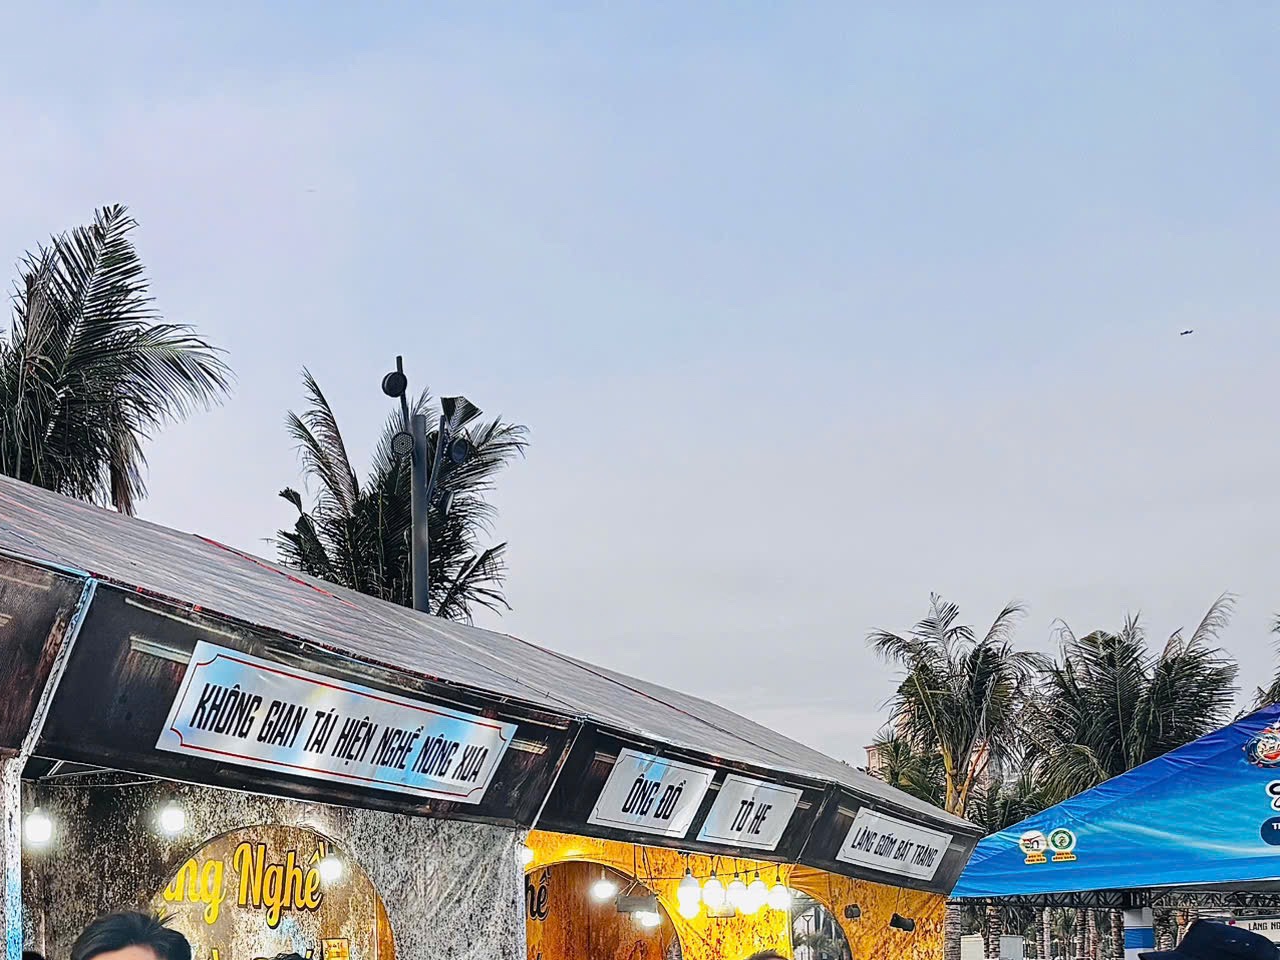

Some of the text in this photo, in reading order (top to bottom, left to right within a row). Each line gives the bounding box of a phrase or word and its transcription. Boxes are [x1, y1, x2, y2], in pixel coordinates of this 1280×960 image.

[189, 683, 263, 739] KHÔNG
[256, 700, 308, 748] GIAN
[303, 707, 339, 755] TÁI
[330, 716, 379, 766] HIỆN
[370, 726, 424, 770] NGHỀ
[411, 733, 460, 778] NÔNG
[621, 773, 687, 820] ÔNG ĐỒ
[746, 802, 773, 835] HE
[851, 826, 938, 868] LÀNG GỐM BÁT TRÀNG
